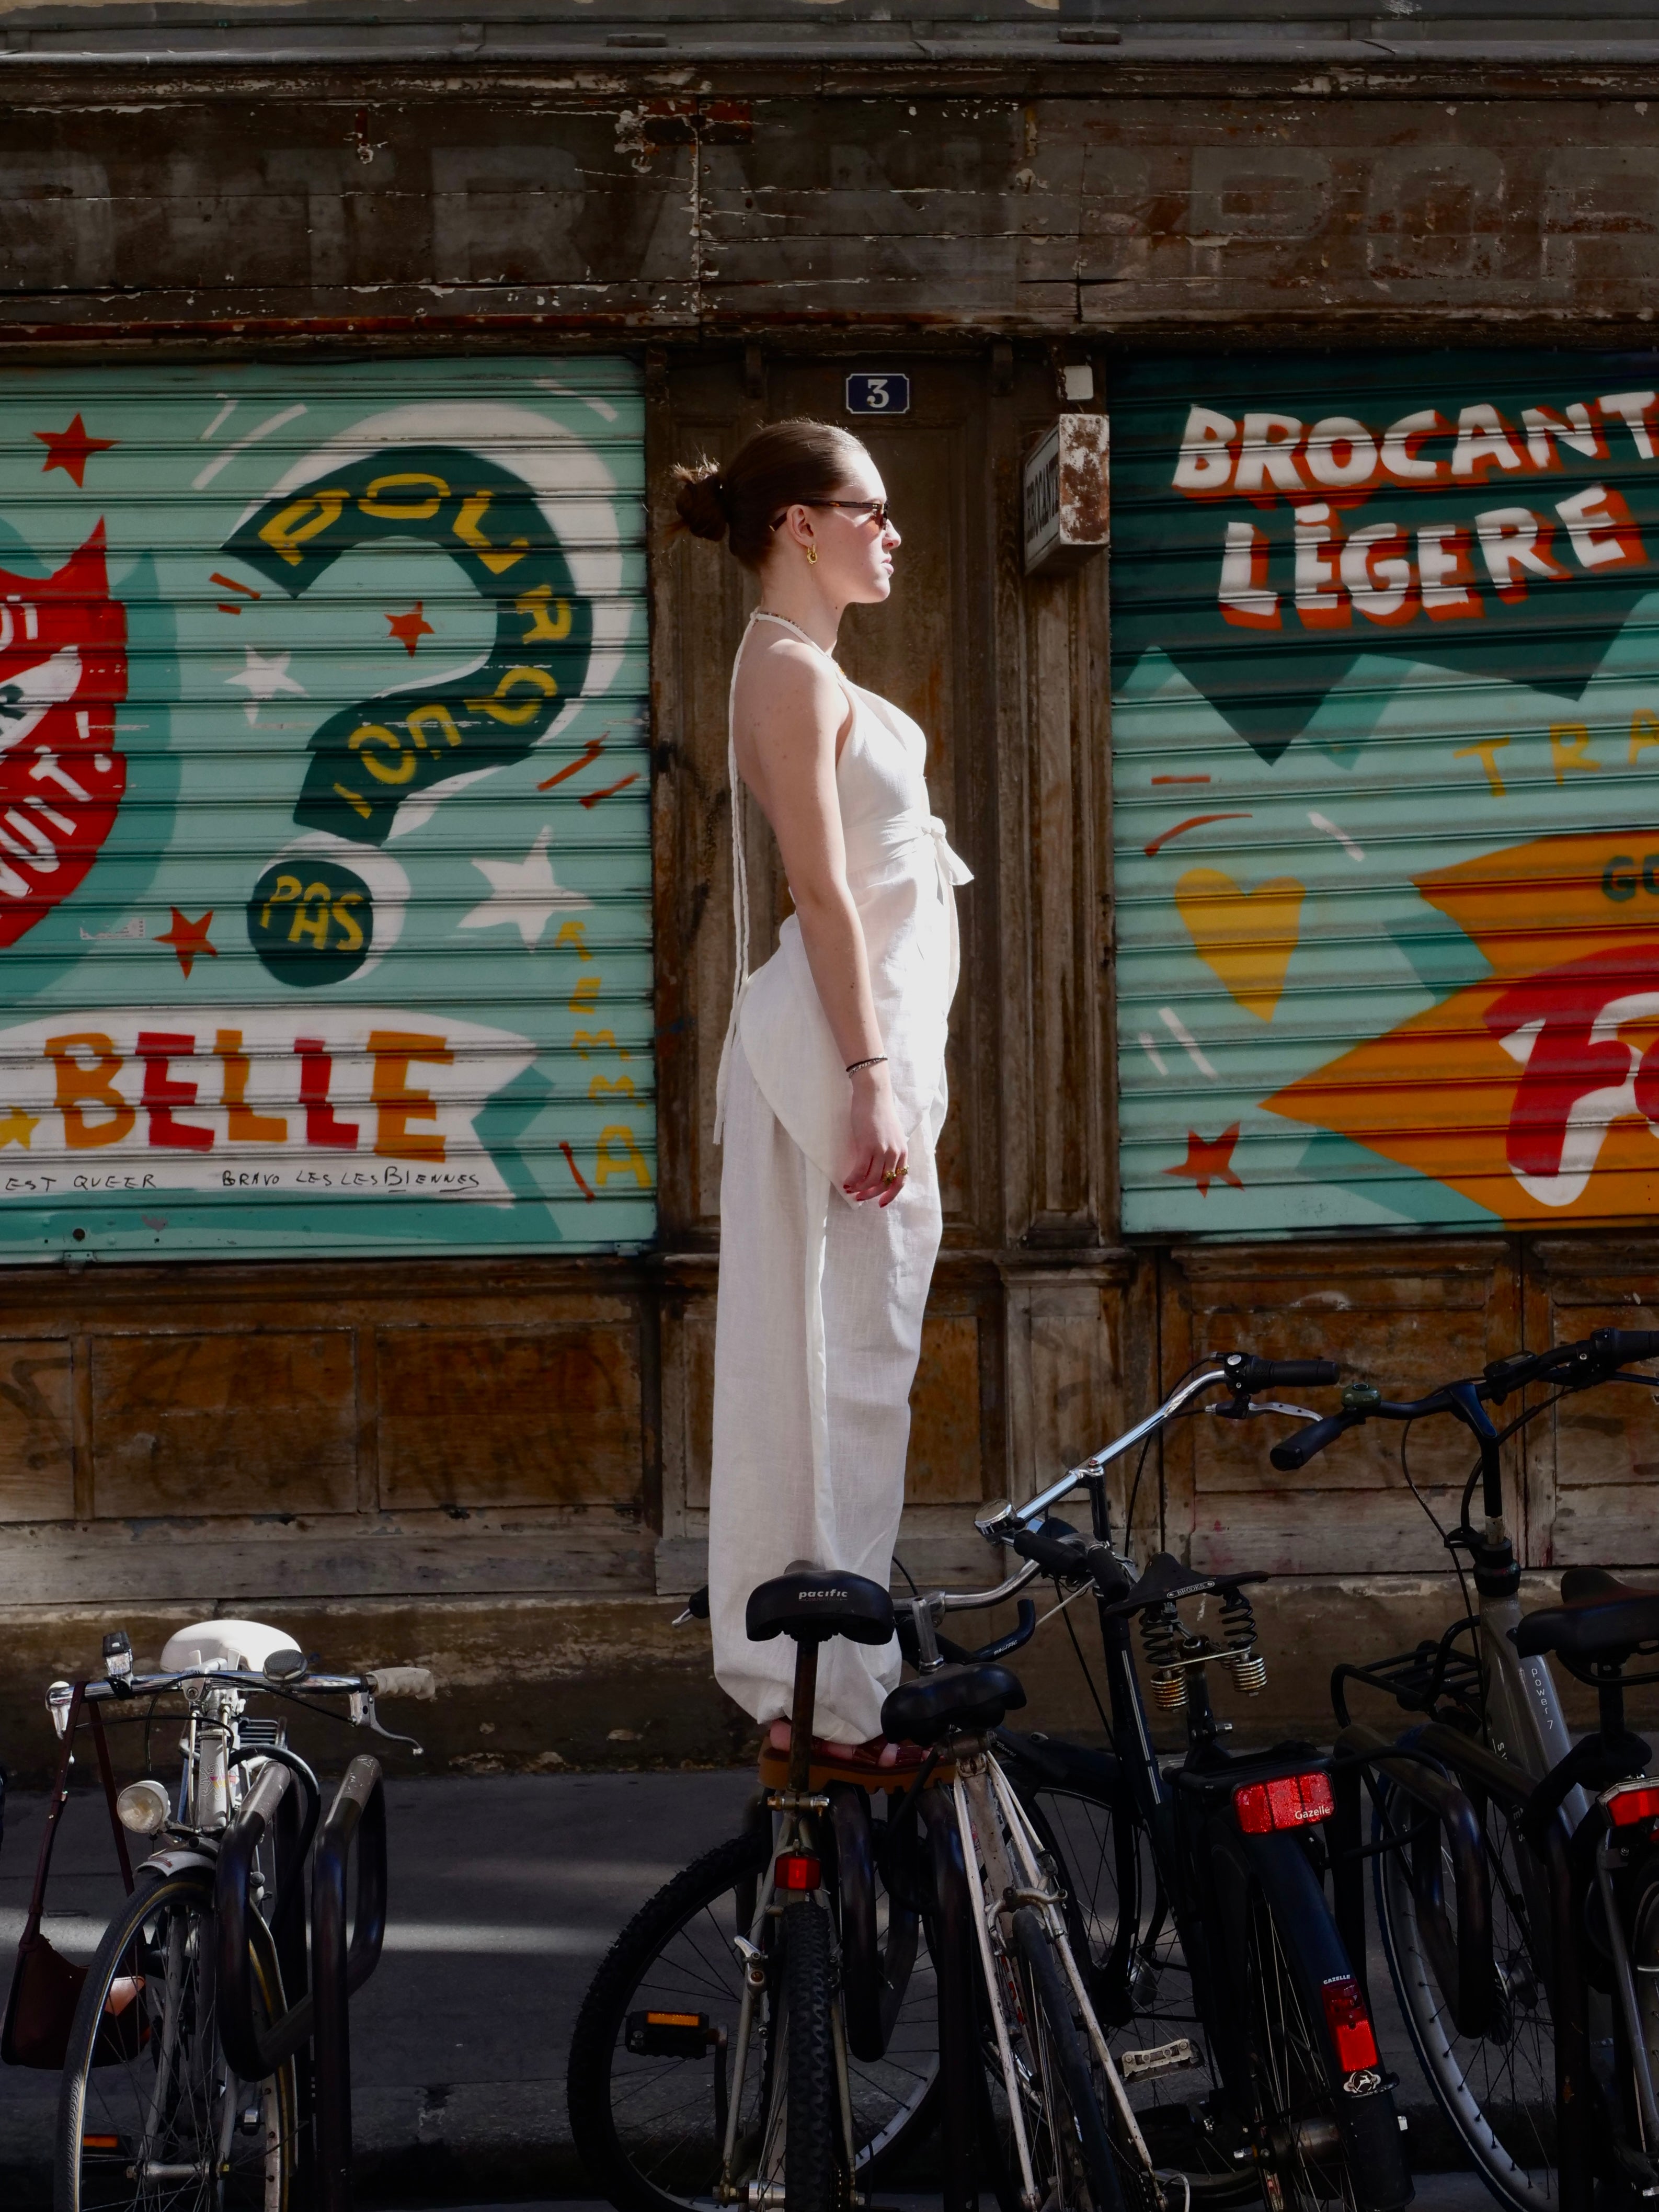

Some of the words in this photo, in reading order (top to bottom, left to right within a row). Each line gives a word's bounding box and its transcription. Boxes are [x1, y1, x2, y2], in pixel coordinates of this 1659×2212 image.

[866, 379, 889, 408] 3
[1172, 391, 1659, 505] BROCANT
[260, 875, 364, 951] PAS
[44, 1029, 454, 1163] BELLE
[5, 1177, 57, 1192] EST
[73, 1174, 157, 1190] QUEER
[222, 1170, 280, 1187] BRAVO
[295, 1170, 332, 1187] LES
[798, 1589, 848, 1600] pacific
[1531, 1668, 1548, 1715] power
[1547, 1719, 1553, 1730] 7
[1295, 1805, 1331, 1820] Gazelle
[1323, 1974, 1351, 1985] GAZELLE
